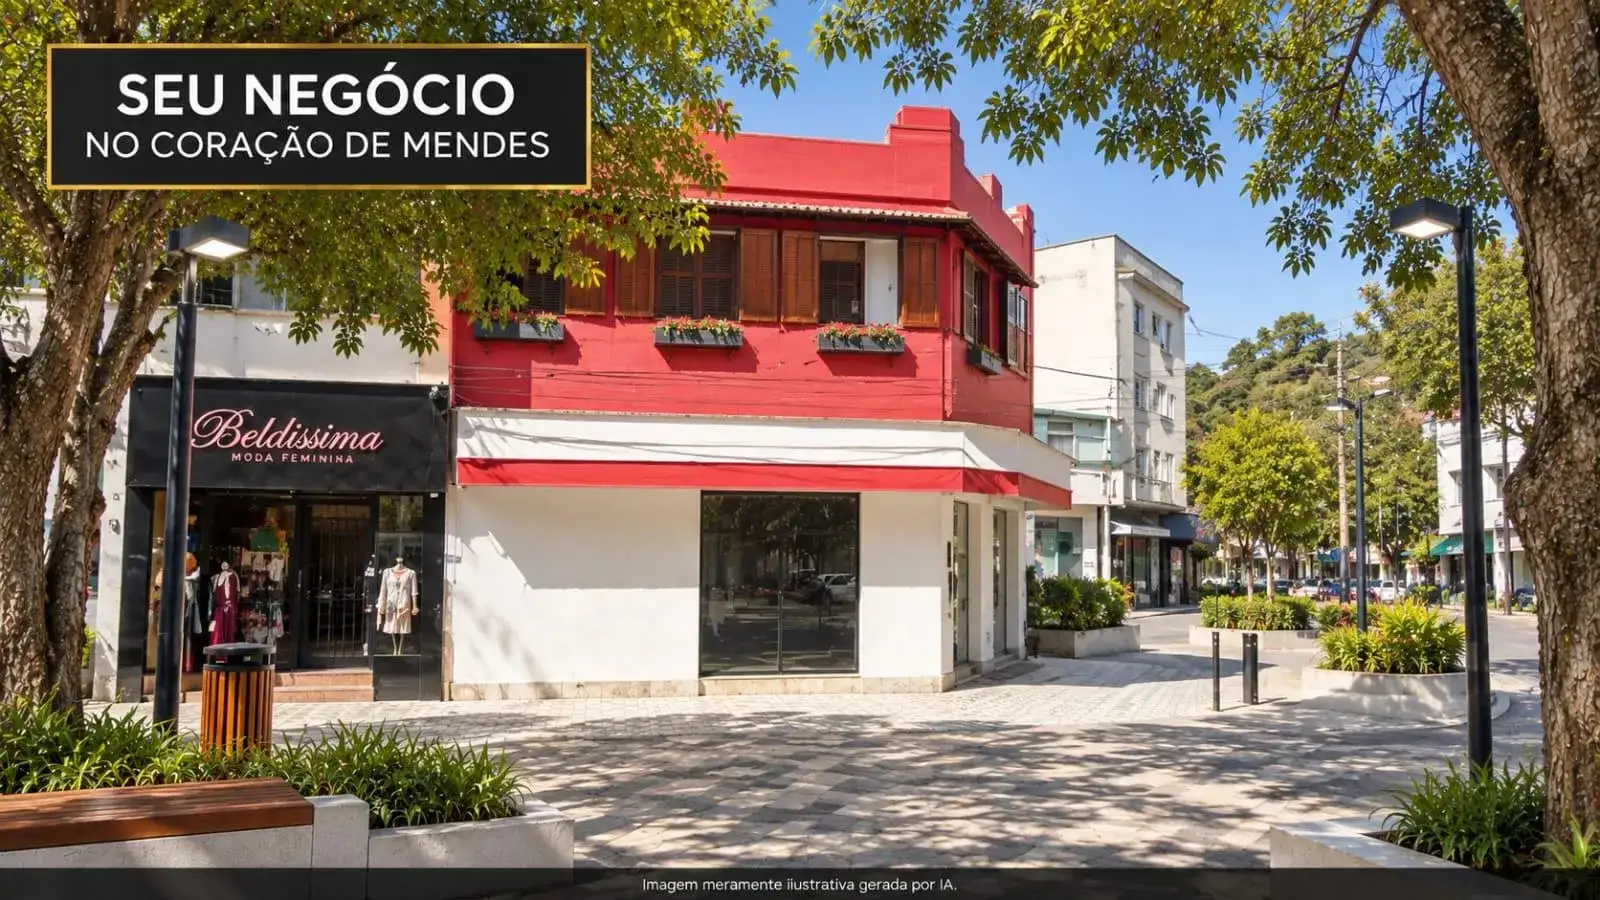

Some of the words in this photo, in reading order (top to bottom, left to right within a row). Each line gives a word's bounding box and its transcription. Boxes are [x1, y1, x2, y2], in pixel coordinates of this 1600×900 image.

[192, 408, 384, 450] Beldissima
[231, 452, 274, 463] MODA
[281, 452, 354, 464] FEMININA
